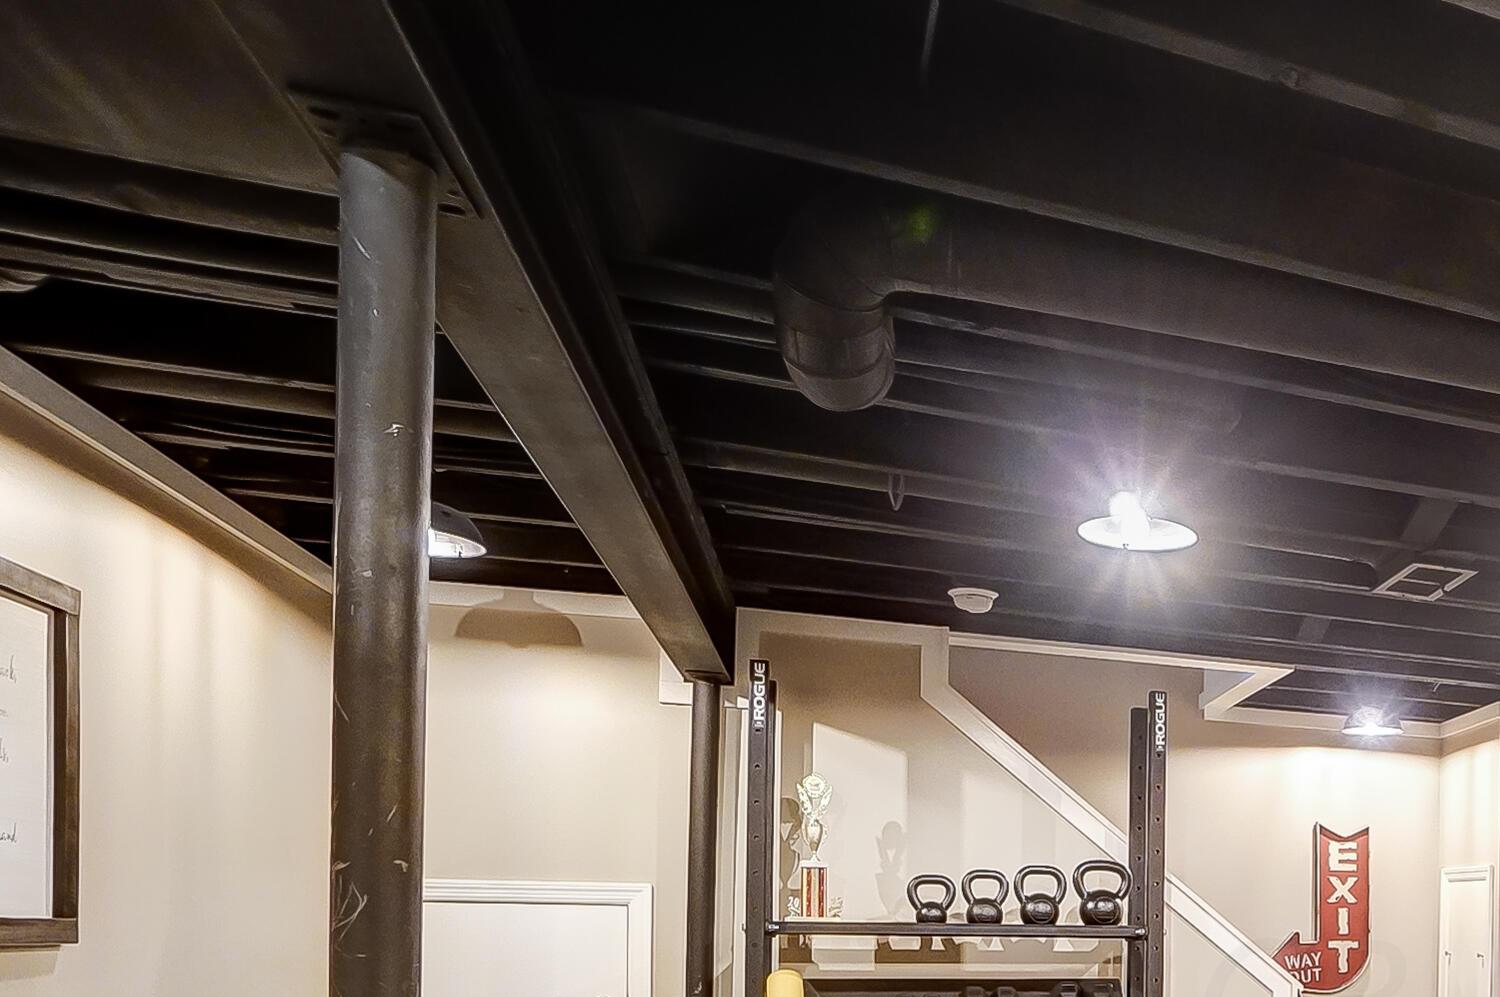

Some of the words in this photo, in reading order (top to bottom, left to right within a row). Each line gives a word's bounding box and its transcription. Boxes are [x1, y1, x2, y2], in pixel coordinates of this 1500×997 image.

[754, 662, 766, 721] ROGUE
[1155, 692, 1166, 746] ROGUE
[1326, 841, 1359, 974] EXIT
[1285, 951, 1321, 969] WAY
